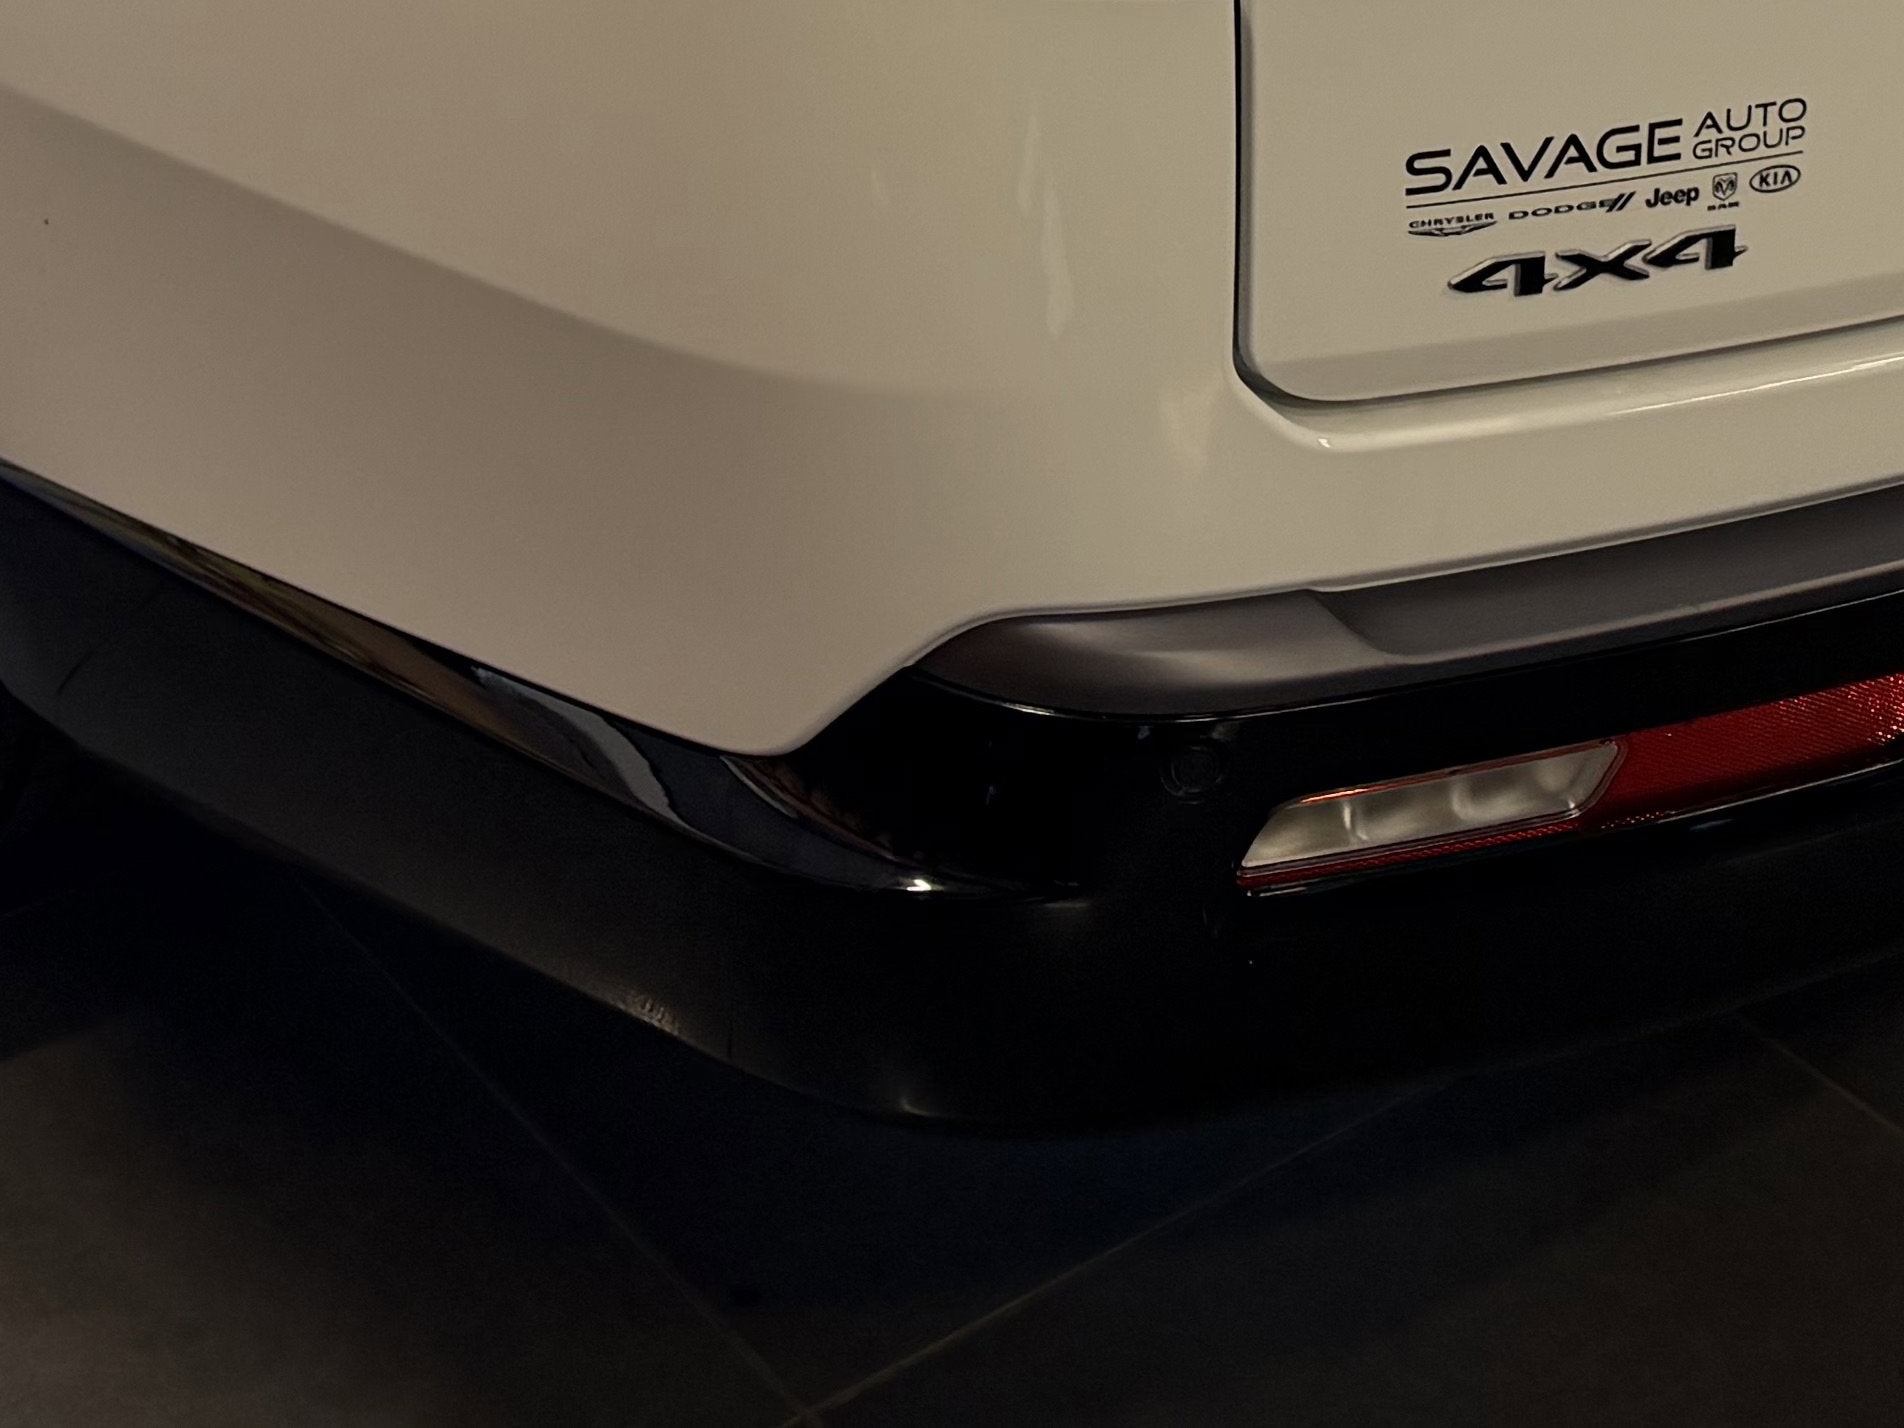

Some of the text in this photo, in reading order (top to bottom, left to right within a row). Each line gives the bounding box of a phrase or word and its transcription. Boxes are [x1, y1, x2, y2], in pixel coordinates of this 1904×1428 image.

[1693, 97, 1808, 138] AUTO
[1404, 117, 1684, 197] SAVAGE
[1692, 125, 1806, 160] GROUP
[1508, 197, 1617, 221] DODGE
[1644, 185, 1701, 209] Jeep
[1408, 212, 1495, 229] CHRYSLER
